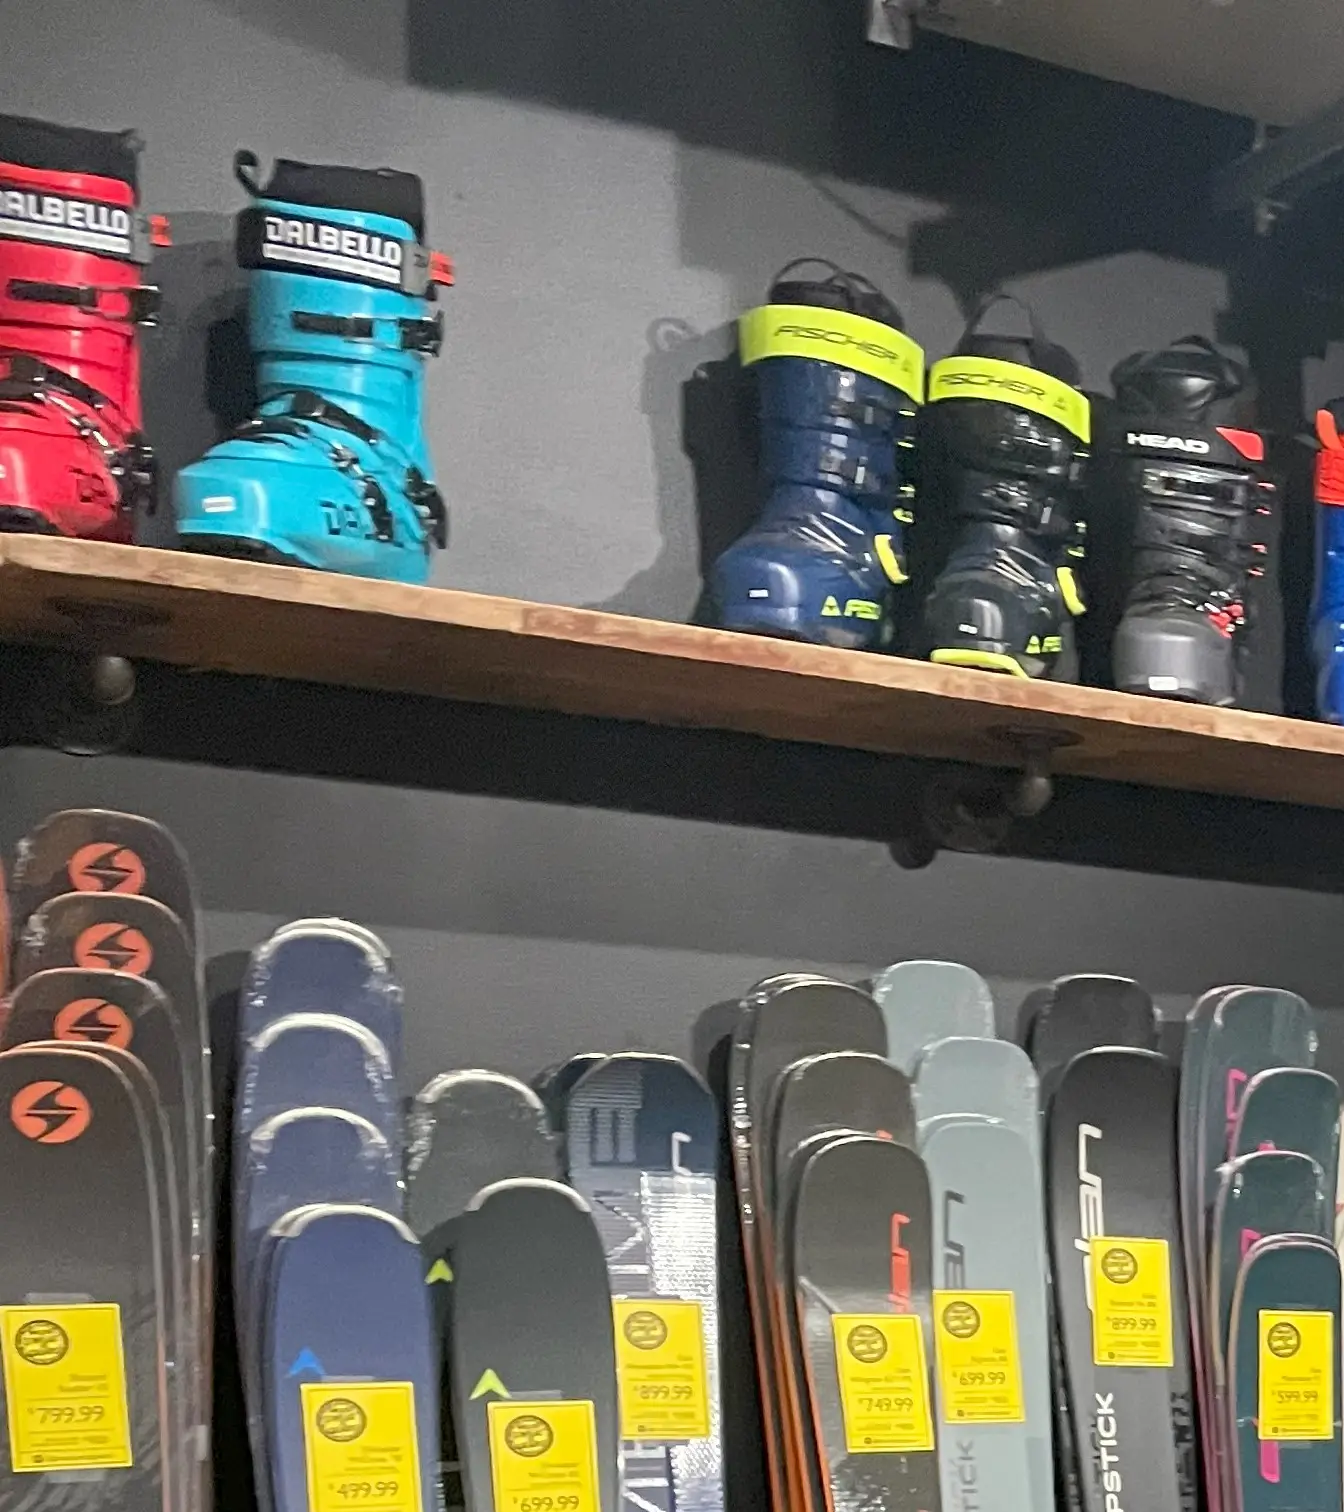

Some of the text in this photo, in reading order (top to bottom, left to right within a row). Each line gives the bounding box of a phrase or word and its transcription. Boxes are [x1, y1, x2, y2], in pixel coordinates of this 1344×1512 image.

[0, 190, 130, 236] ALBELLO
[264, 216, 402, 268] DALBELLO
[774, 323, 898, 365] FISCHER
[938, 371, 1046, 401] FISCHER
[1126, 430, 1210, 455] HEAD
